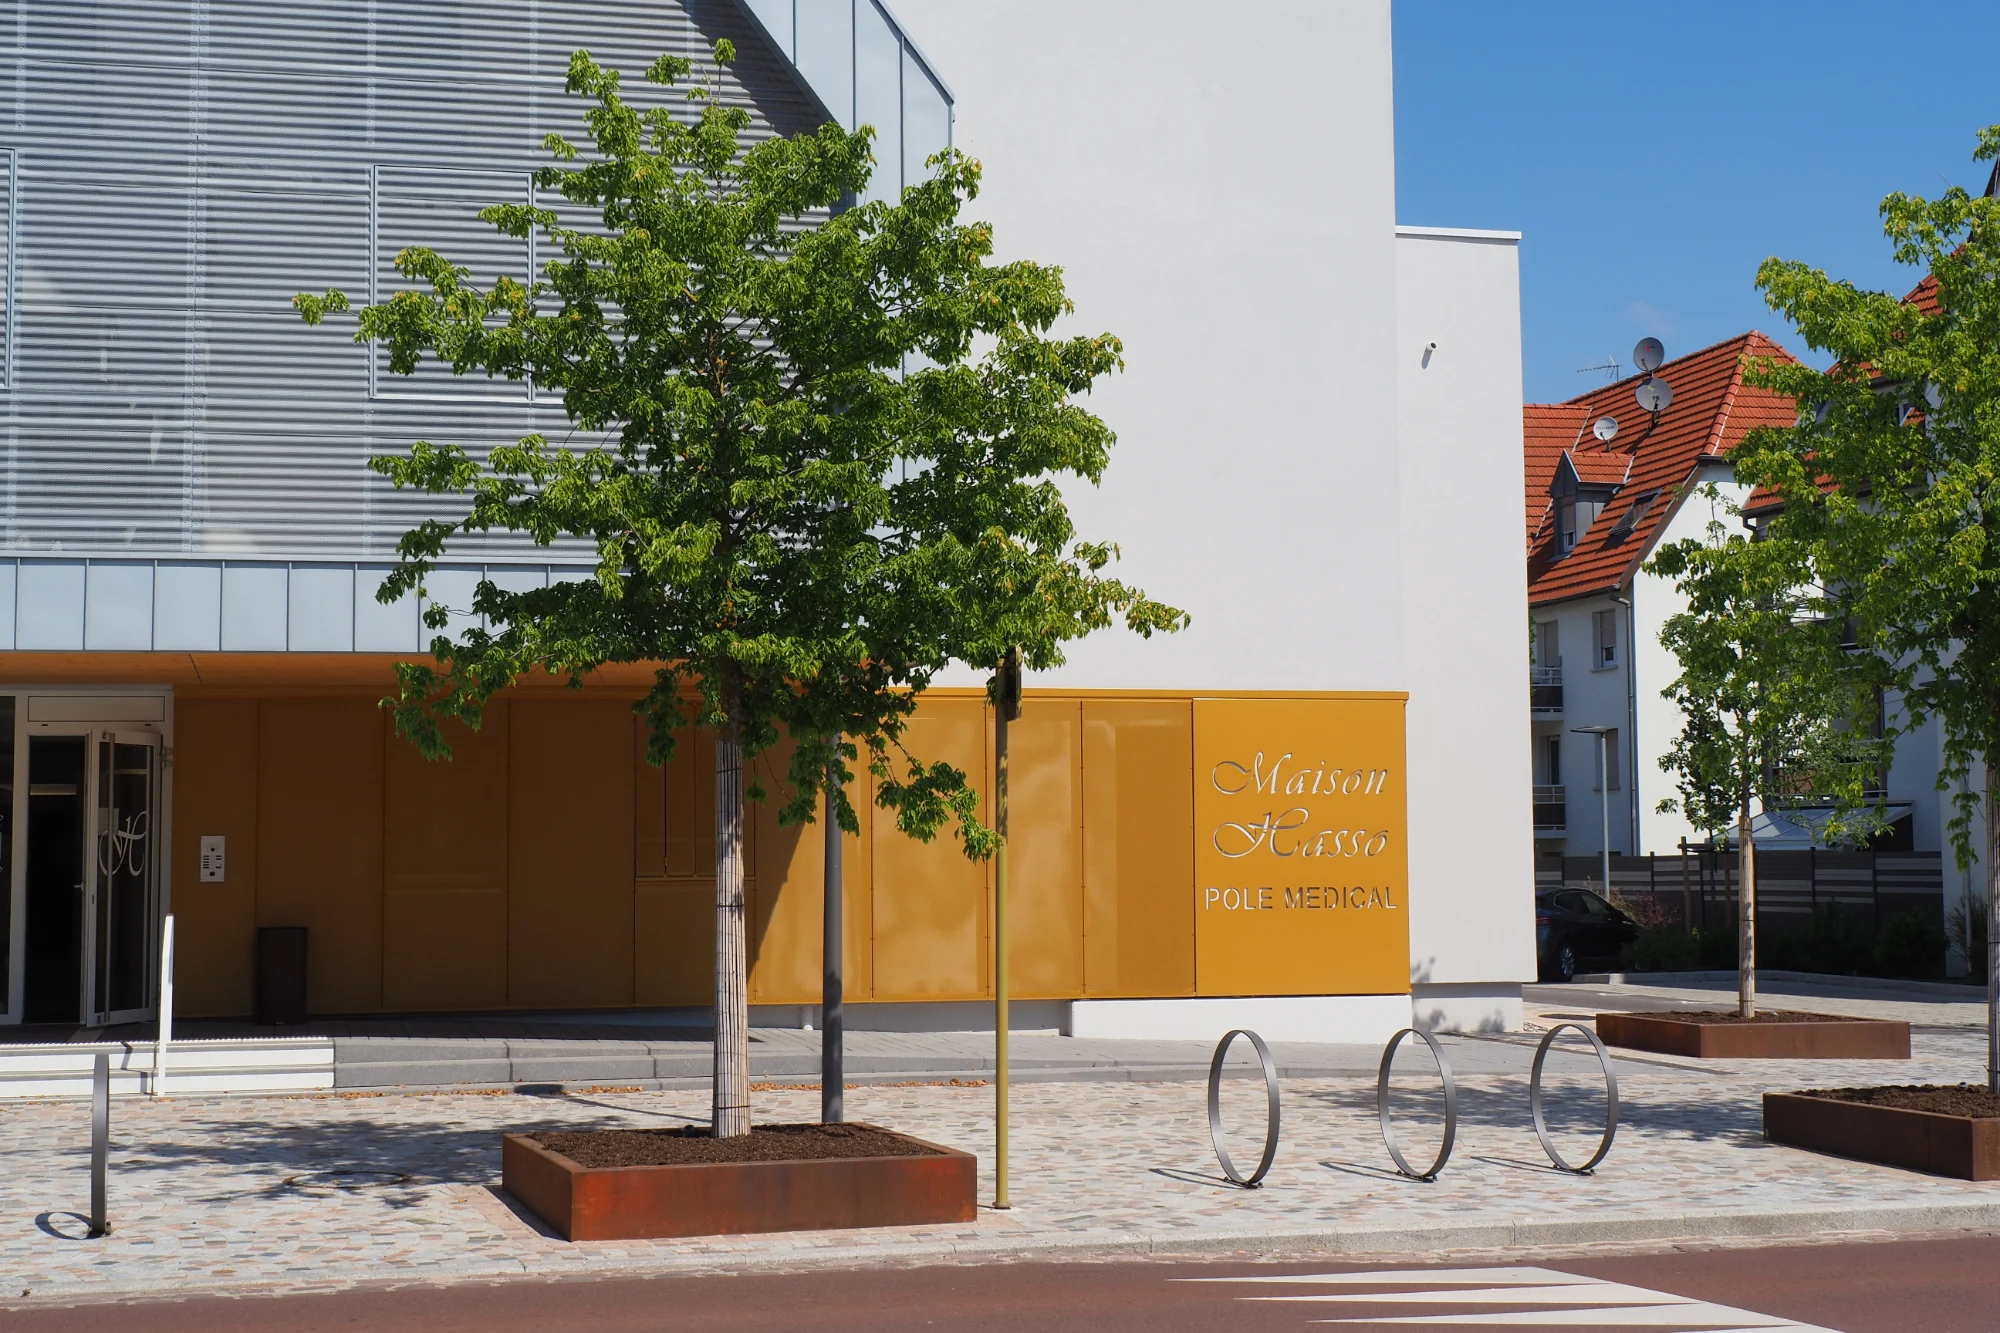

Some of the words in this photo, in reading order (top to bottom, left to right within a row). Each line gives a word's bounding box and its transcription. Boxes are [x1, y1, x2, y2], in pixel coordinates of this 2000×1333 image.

[1212, 751, 1388, 795] Maison
[1213, 807, 1389, 858] Hasso
[1204, 887, 1274, 910] POLE
[1285, 886, 1398, 909] MEDICAL
